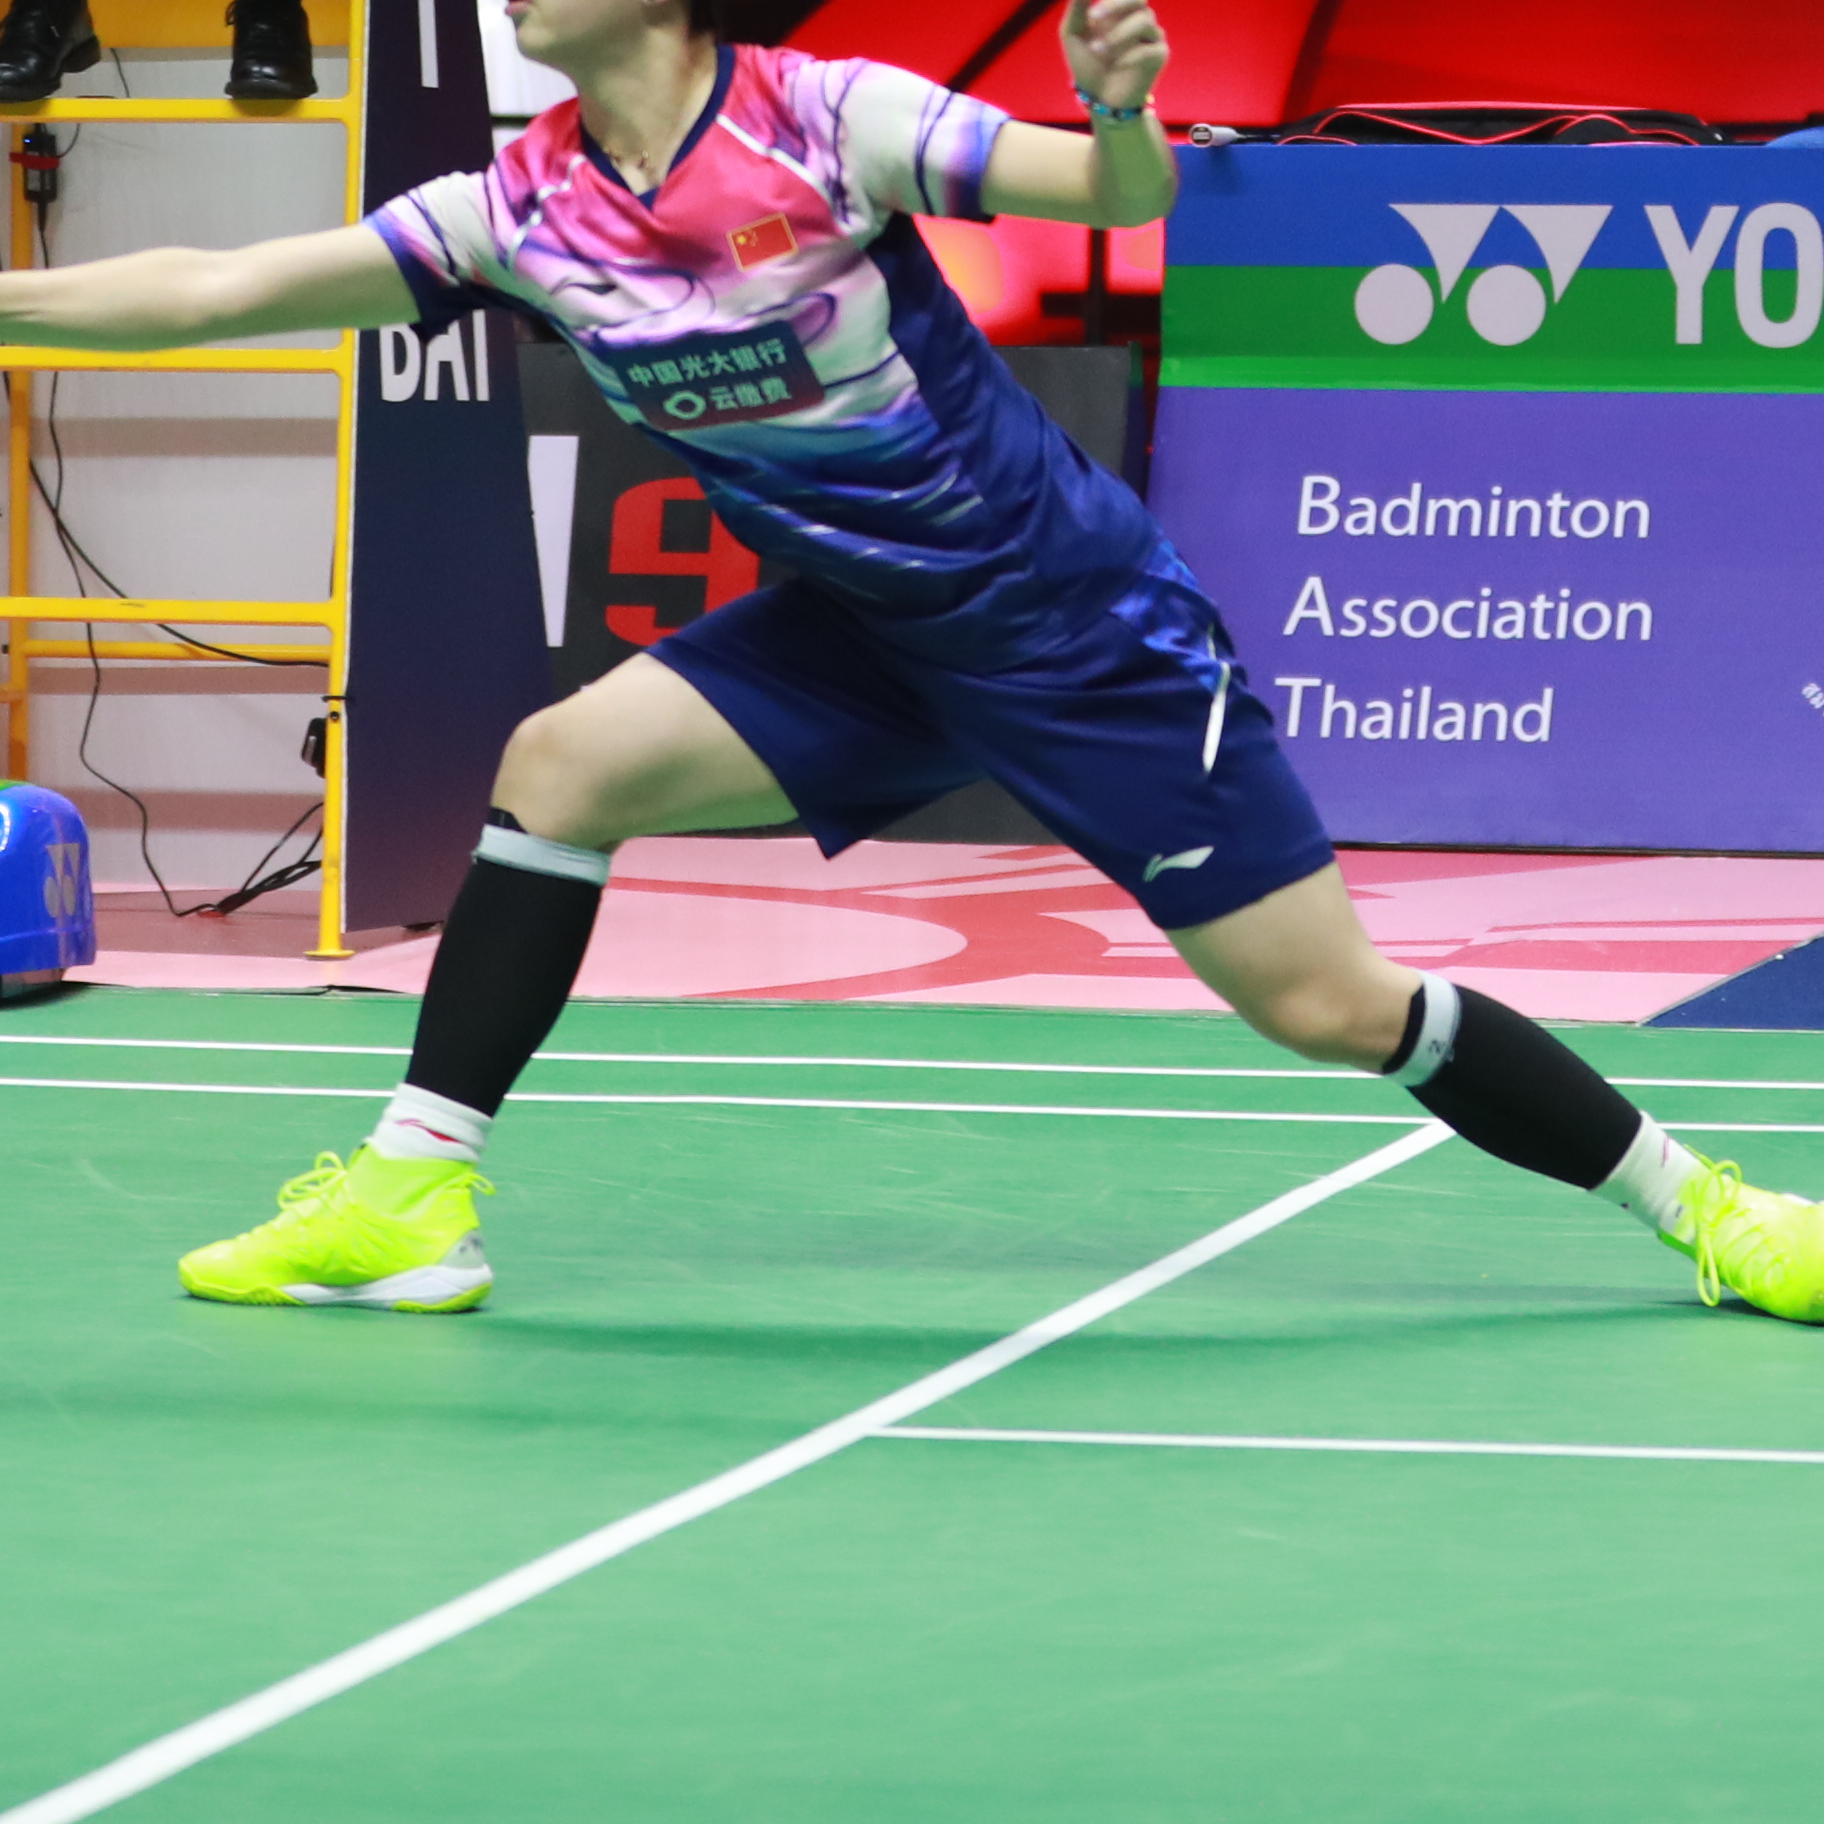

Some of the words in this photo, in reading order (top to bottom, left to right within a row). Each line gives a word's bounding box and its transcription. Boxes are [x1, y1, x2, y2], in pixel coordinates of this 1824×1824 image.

[1295, 474, 1651, 540] Badminton
[1282, 577, 1654, 643] Association
[1272, 677, 1555, 745] Thailand
